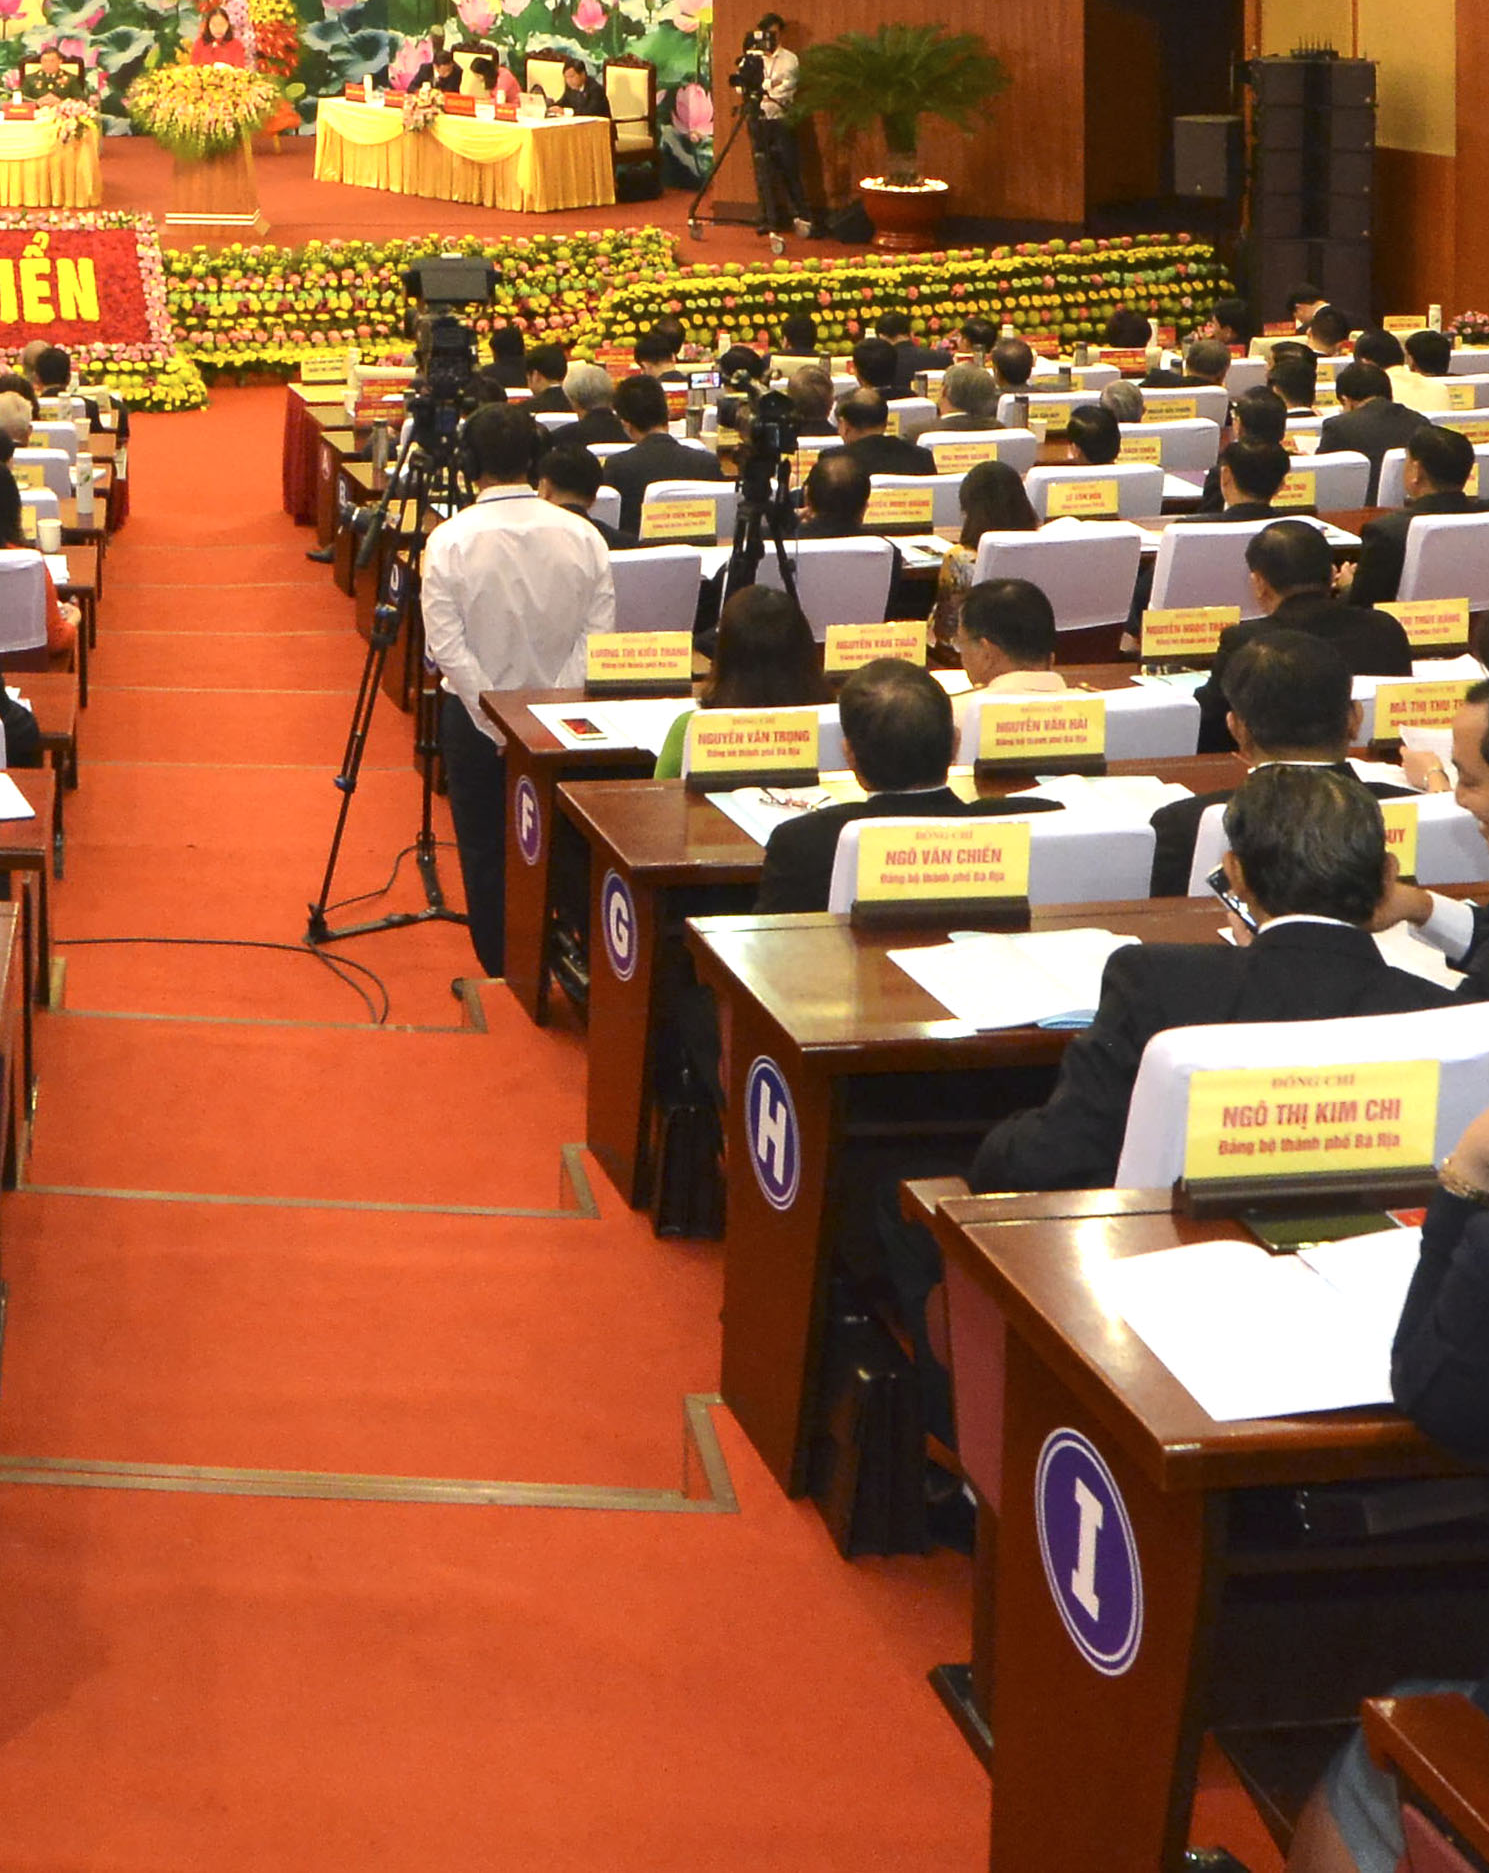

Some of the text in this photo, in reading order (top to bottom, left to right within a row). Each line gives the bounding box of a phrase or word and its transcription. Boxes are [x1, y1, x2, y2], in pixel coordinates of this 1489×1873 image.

[522, 791, 534, 841] F
[610, 891, 629, 958] G
[758, 1079, 786, 1184] H
[1224, 1100, 1402, 1129] NGÔ THỊ KIM CHI
[1072, 1477, 1104, 1622] I
